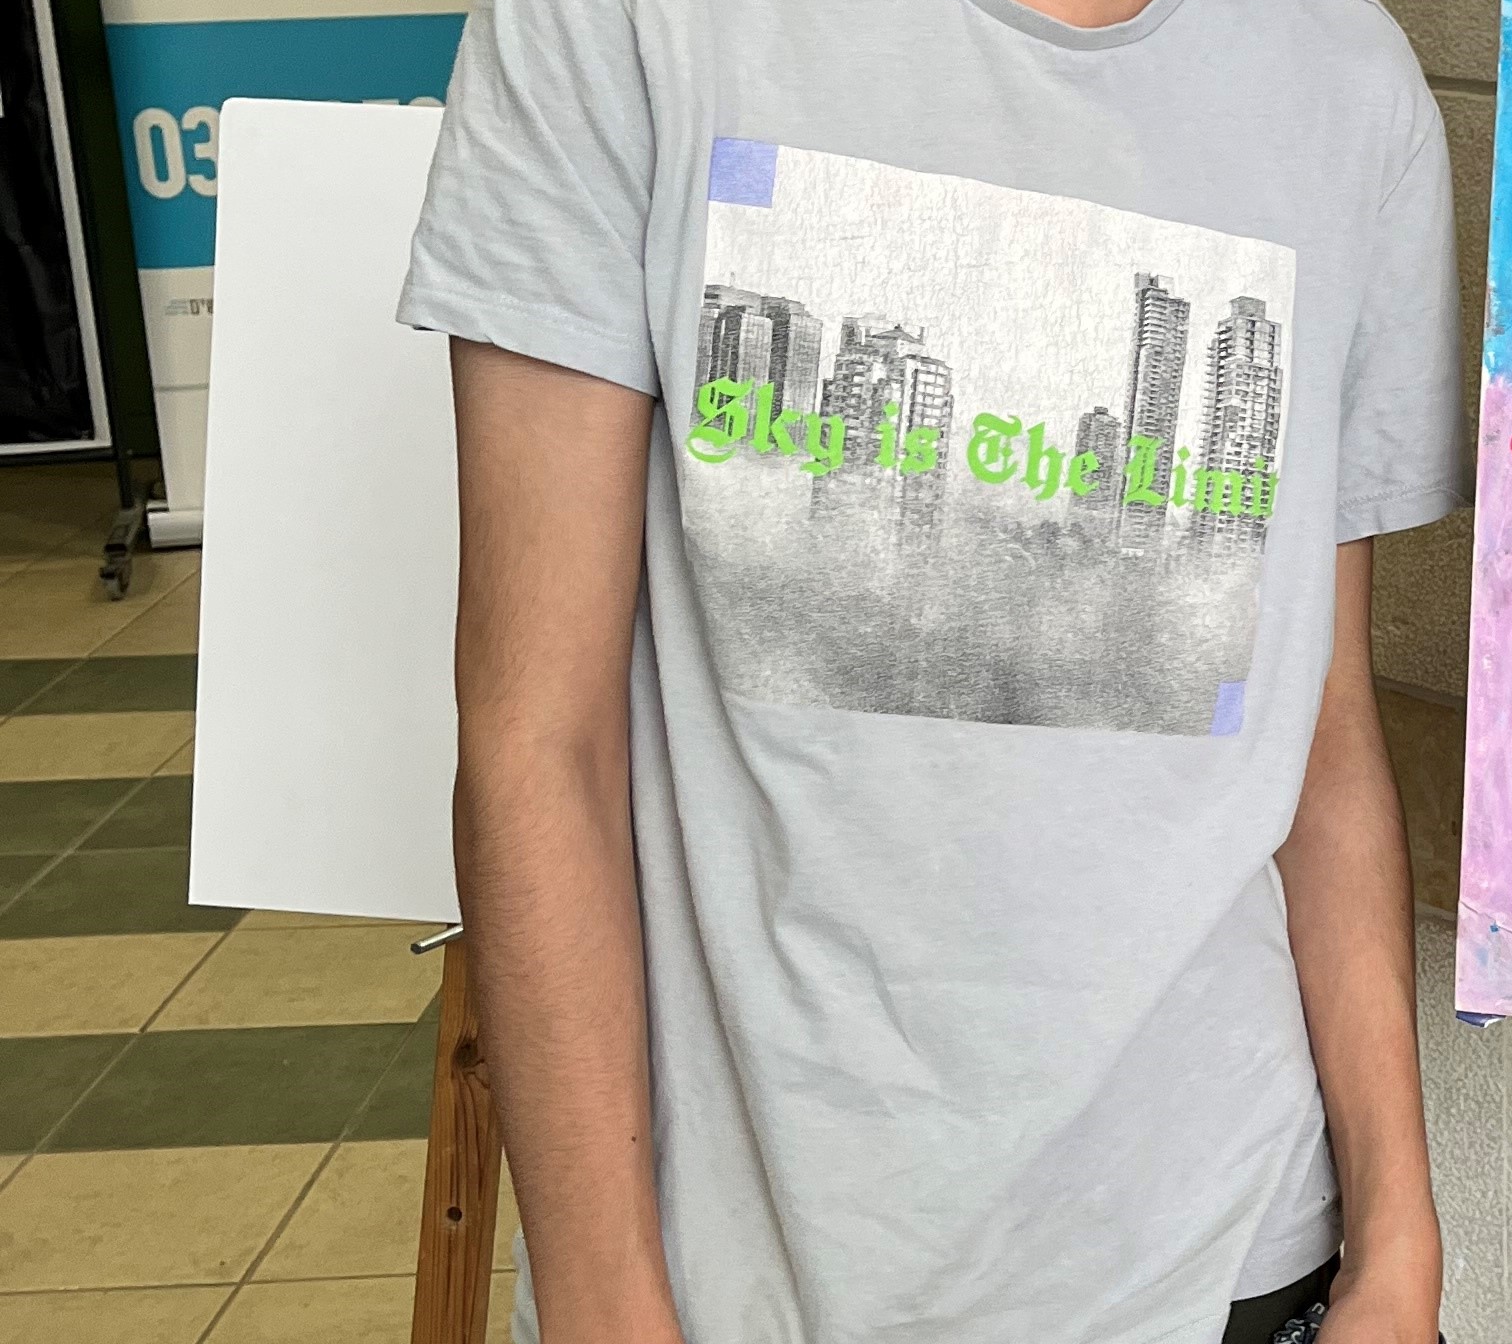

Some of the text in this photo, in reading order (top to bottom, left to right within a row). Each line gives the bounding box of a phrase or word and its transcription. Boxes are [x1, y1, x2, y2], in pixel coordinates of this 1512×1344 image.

[133, 106, 219, 198] 03
[685, 377, 845, 476] Sky
[874, 402, 940, 475] is
[966, 412, 1102, 502] The
